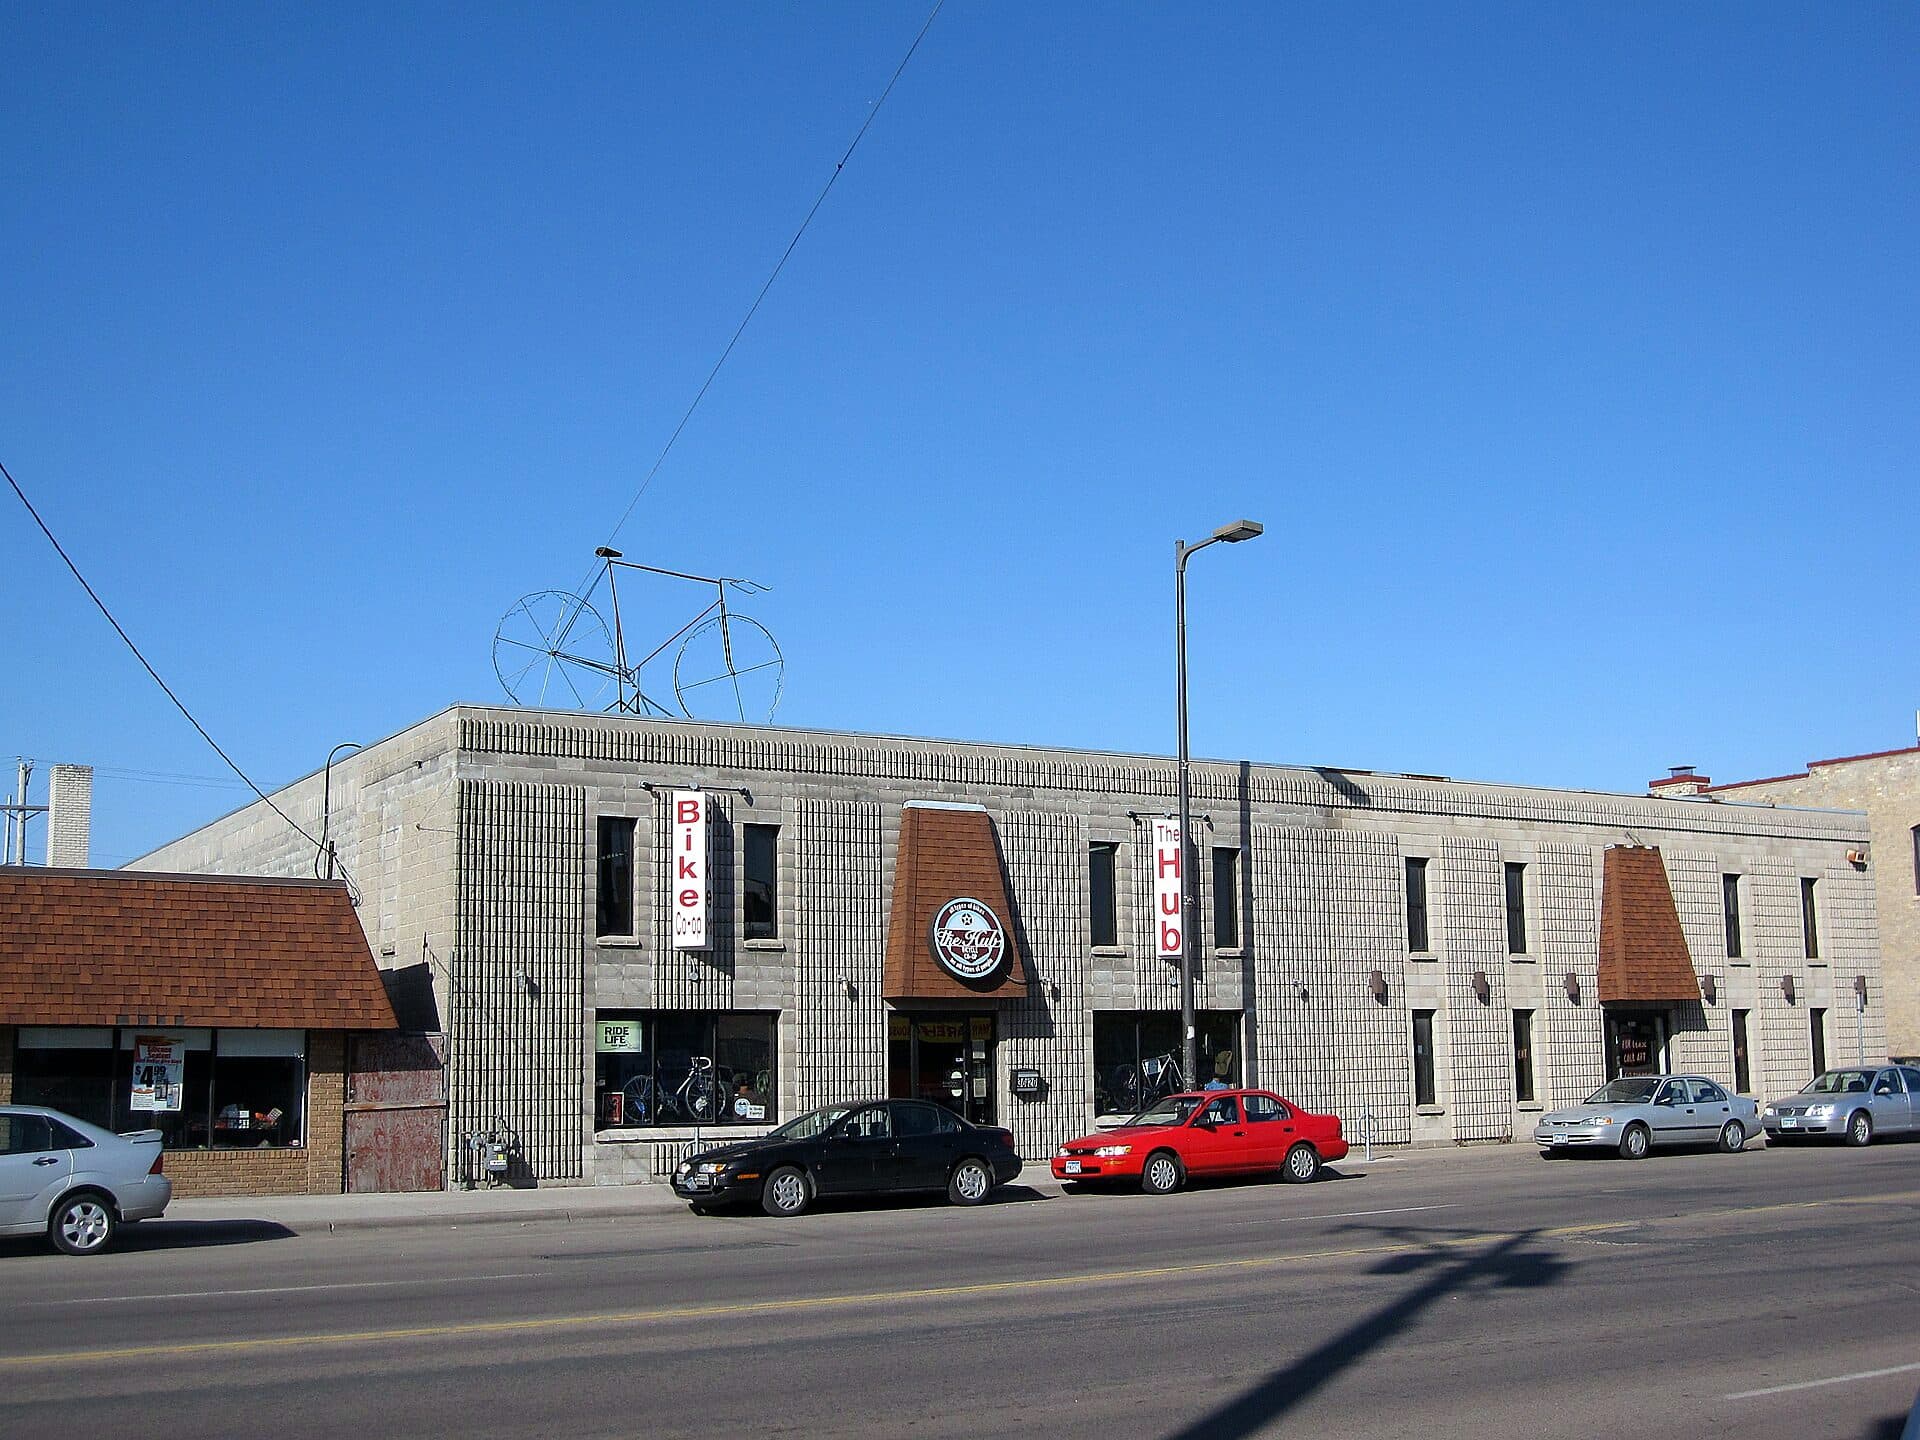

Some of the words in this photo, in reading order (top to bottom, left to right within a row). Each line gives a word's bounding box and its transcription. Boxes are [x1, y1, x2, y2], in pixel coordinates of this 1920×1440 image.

[1157, 825, 1180, 842] The
[677, 800, 700, 907] Bike
[1158, 848, 1181, 951] Hub
[604, 1026, 630, 1036] RIDE
[604, 1035, 626, 1044] LIFE
